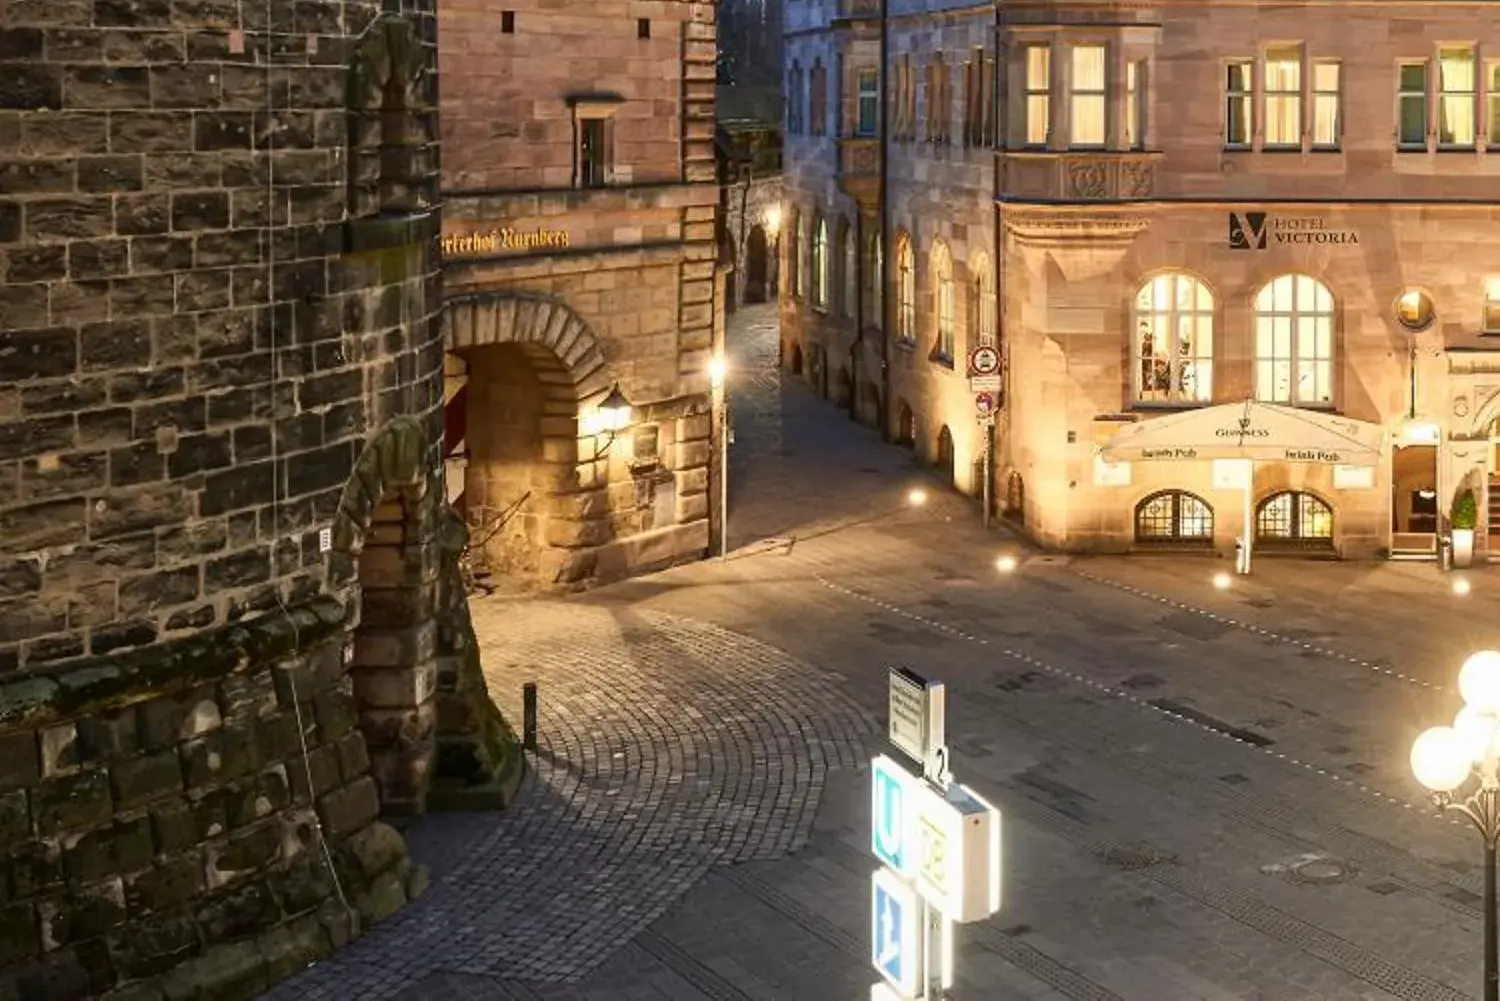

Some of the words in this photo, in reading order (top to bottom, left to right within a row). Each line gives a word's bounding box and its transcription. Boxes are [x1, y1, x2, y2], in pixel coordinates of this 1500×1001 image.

[1274, 217, 1327, 230] HOTEL
[1274, 231, 1359, 244] VICTORIA
[1215, 428, 1270, 438] GUINNESS
[1174, 448, 1198, 459] Pub
[1285, 450, 1315, 461] Irish
[1317, 451, 1341, 463] Pub
